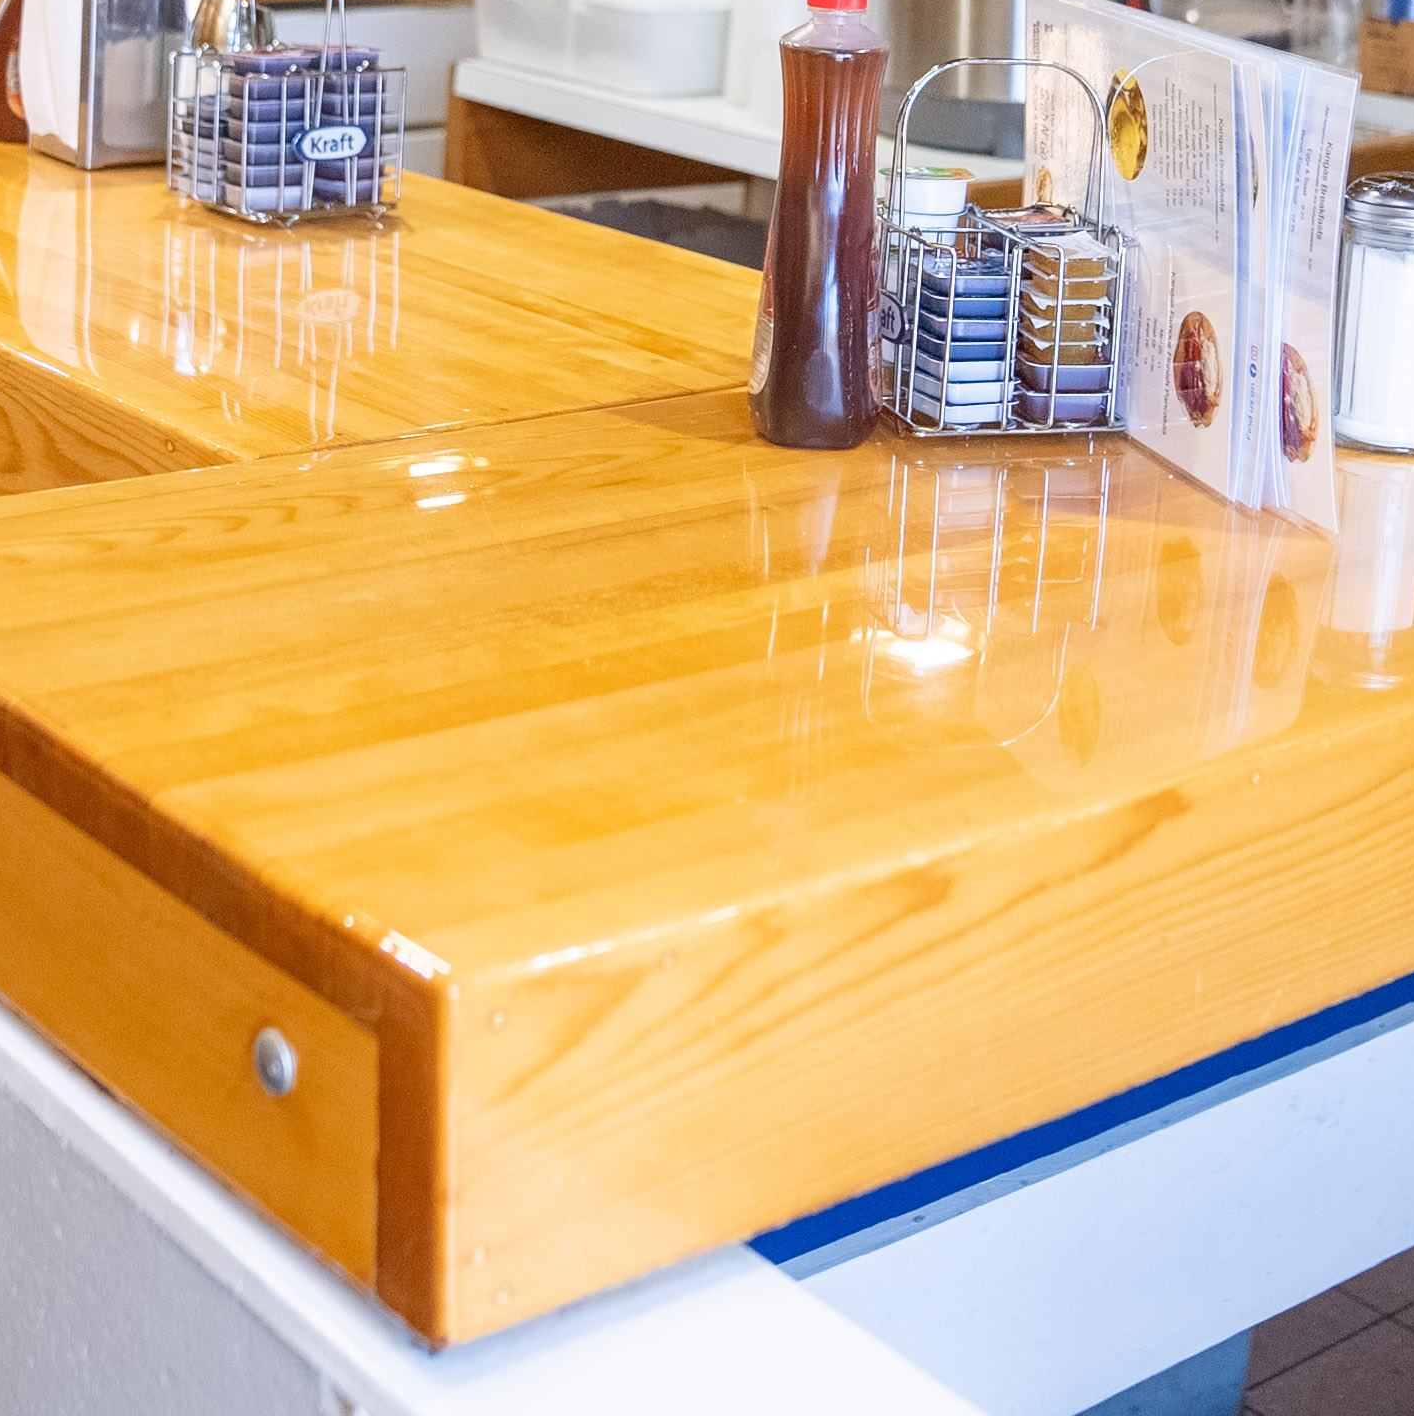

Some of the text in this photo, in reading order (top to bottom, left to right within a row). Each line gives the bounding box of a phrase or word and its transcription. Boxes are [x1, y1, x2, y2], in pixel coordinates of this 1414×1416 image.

[310, 132, 354, 154] Kraft
[1316, 142, 1333, 240] Kangas Breakfasts
[881, 305, 896, 334] aft
